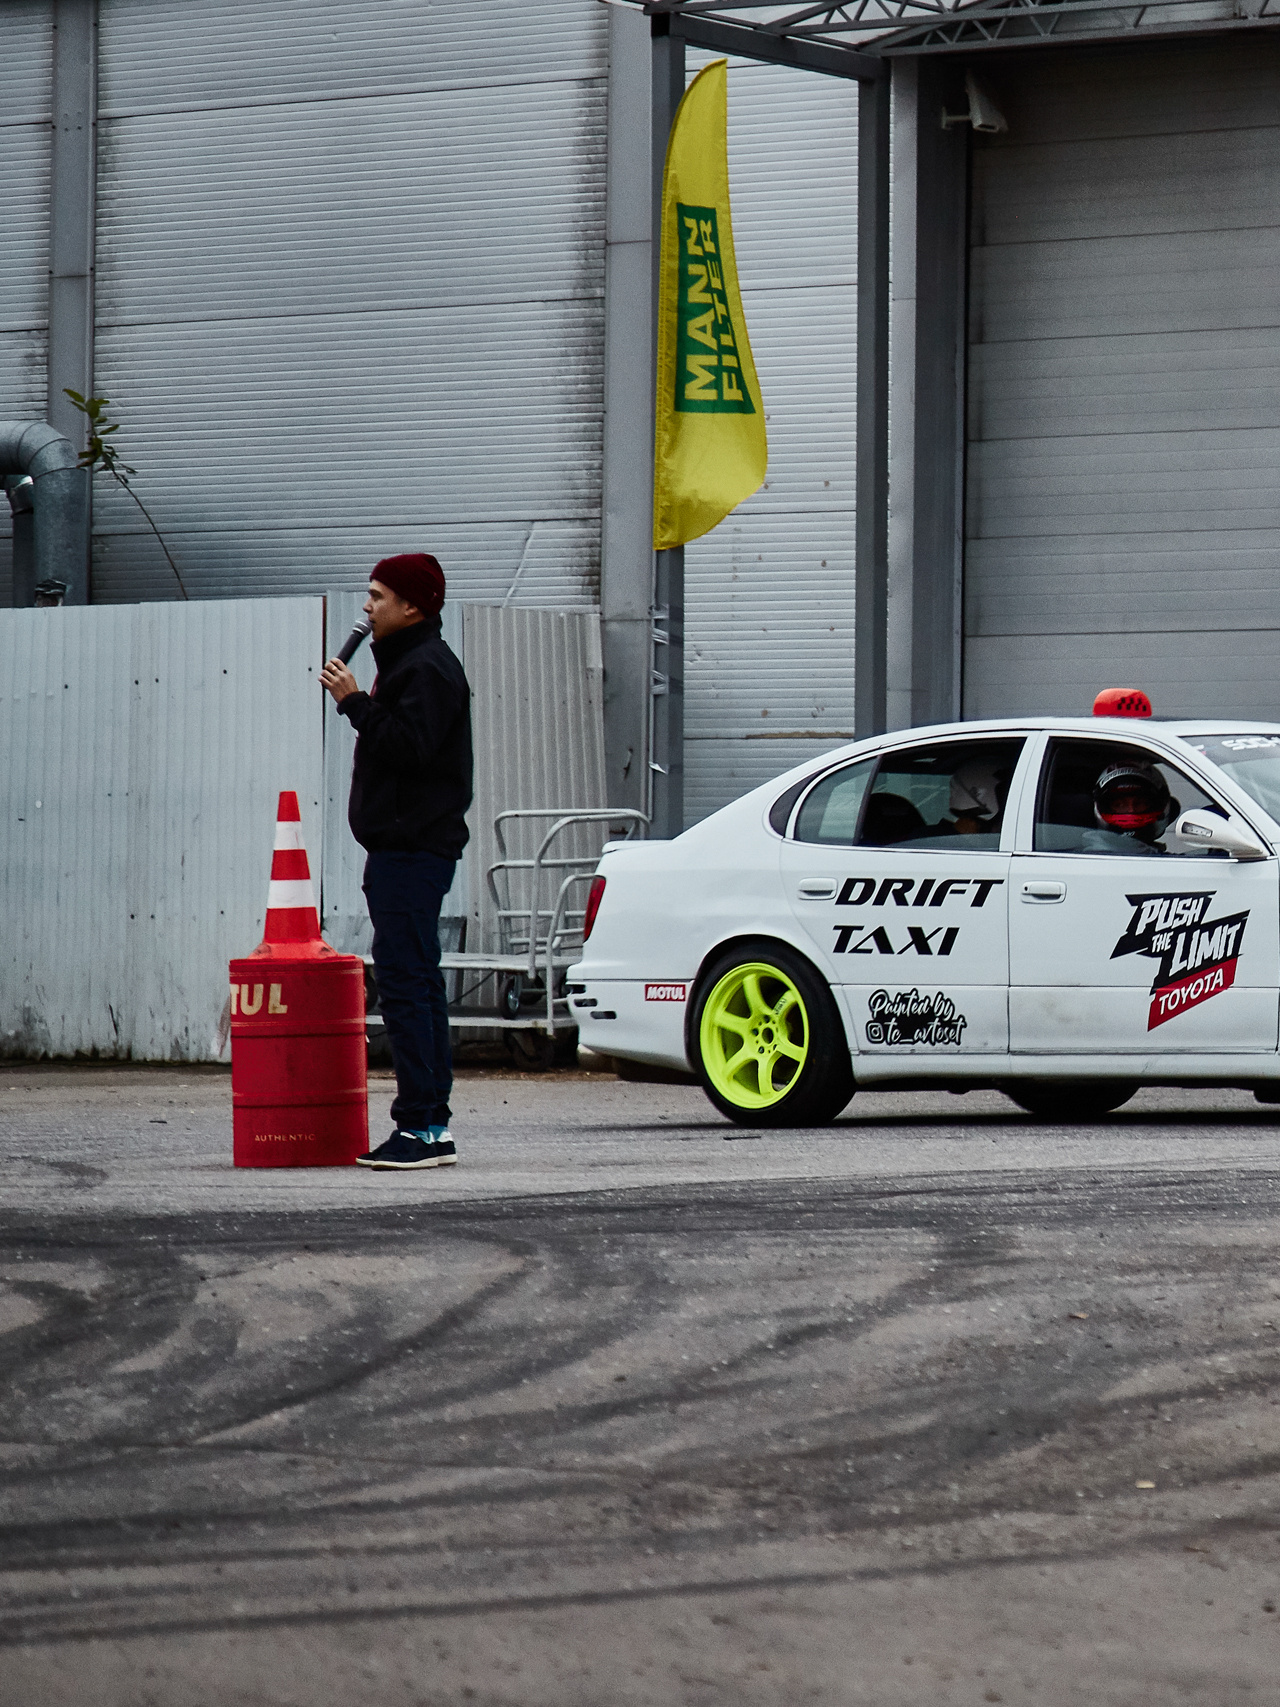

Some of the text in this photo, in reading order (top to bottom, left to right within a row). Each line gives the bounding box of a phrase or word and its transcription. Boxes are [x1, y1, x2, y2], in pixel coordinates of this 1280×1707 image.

[683, 217, 719, 401] MANN
[699, 218, 745, 401] FILTER
[835, 877, 1005, 907] DRIFT
[1135, 897, 1204, 936] PUSH
[832, 925, 960, 955] TAXI
[1152, 931, 1174, 953] THE
[1169, 921, 1242, 977] LIMIT
[646, 986, 685, 1000] MOTUL
[869, 989, 955, 1021] Painted by
[1158, 968, 1224, 1015] TOYOTA
[254, 1133, 316, 1142] AUTHENTIC
